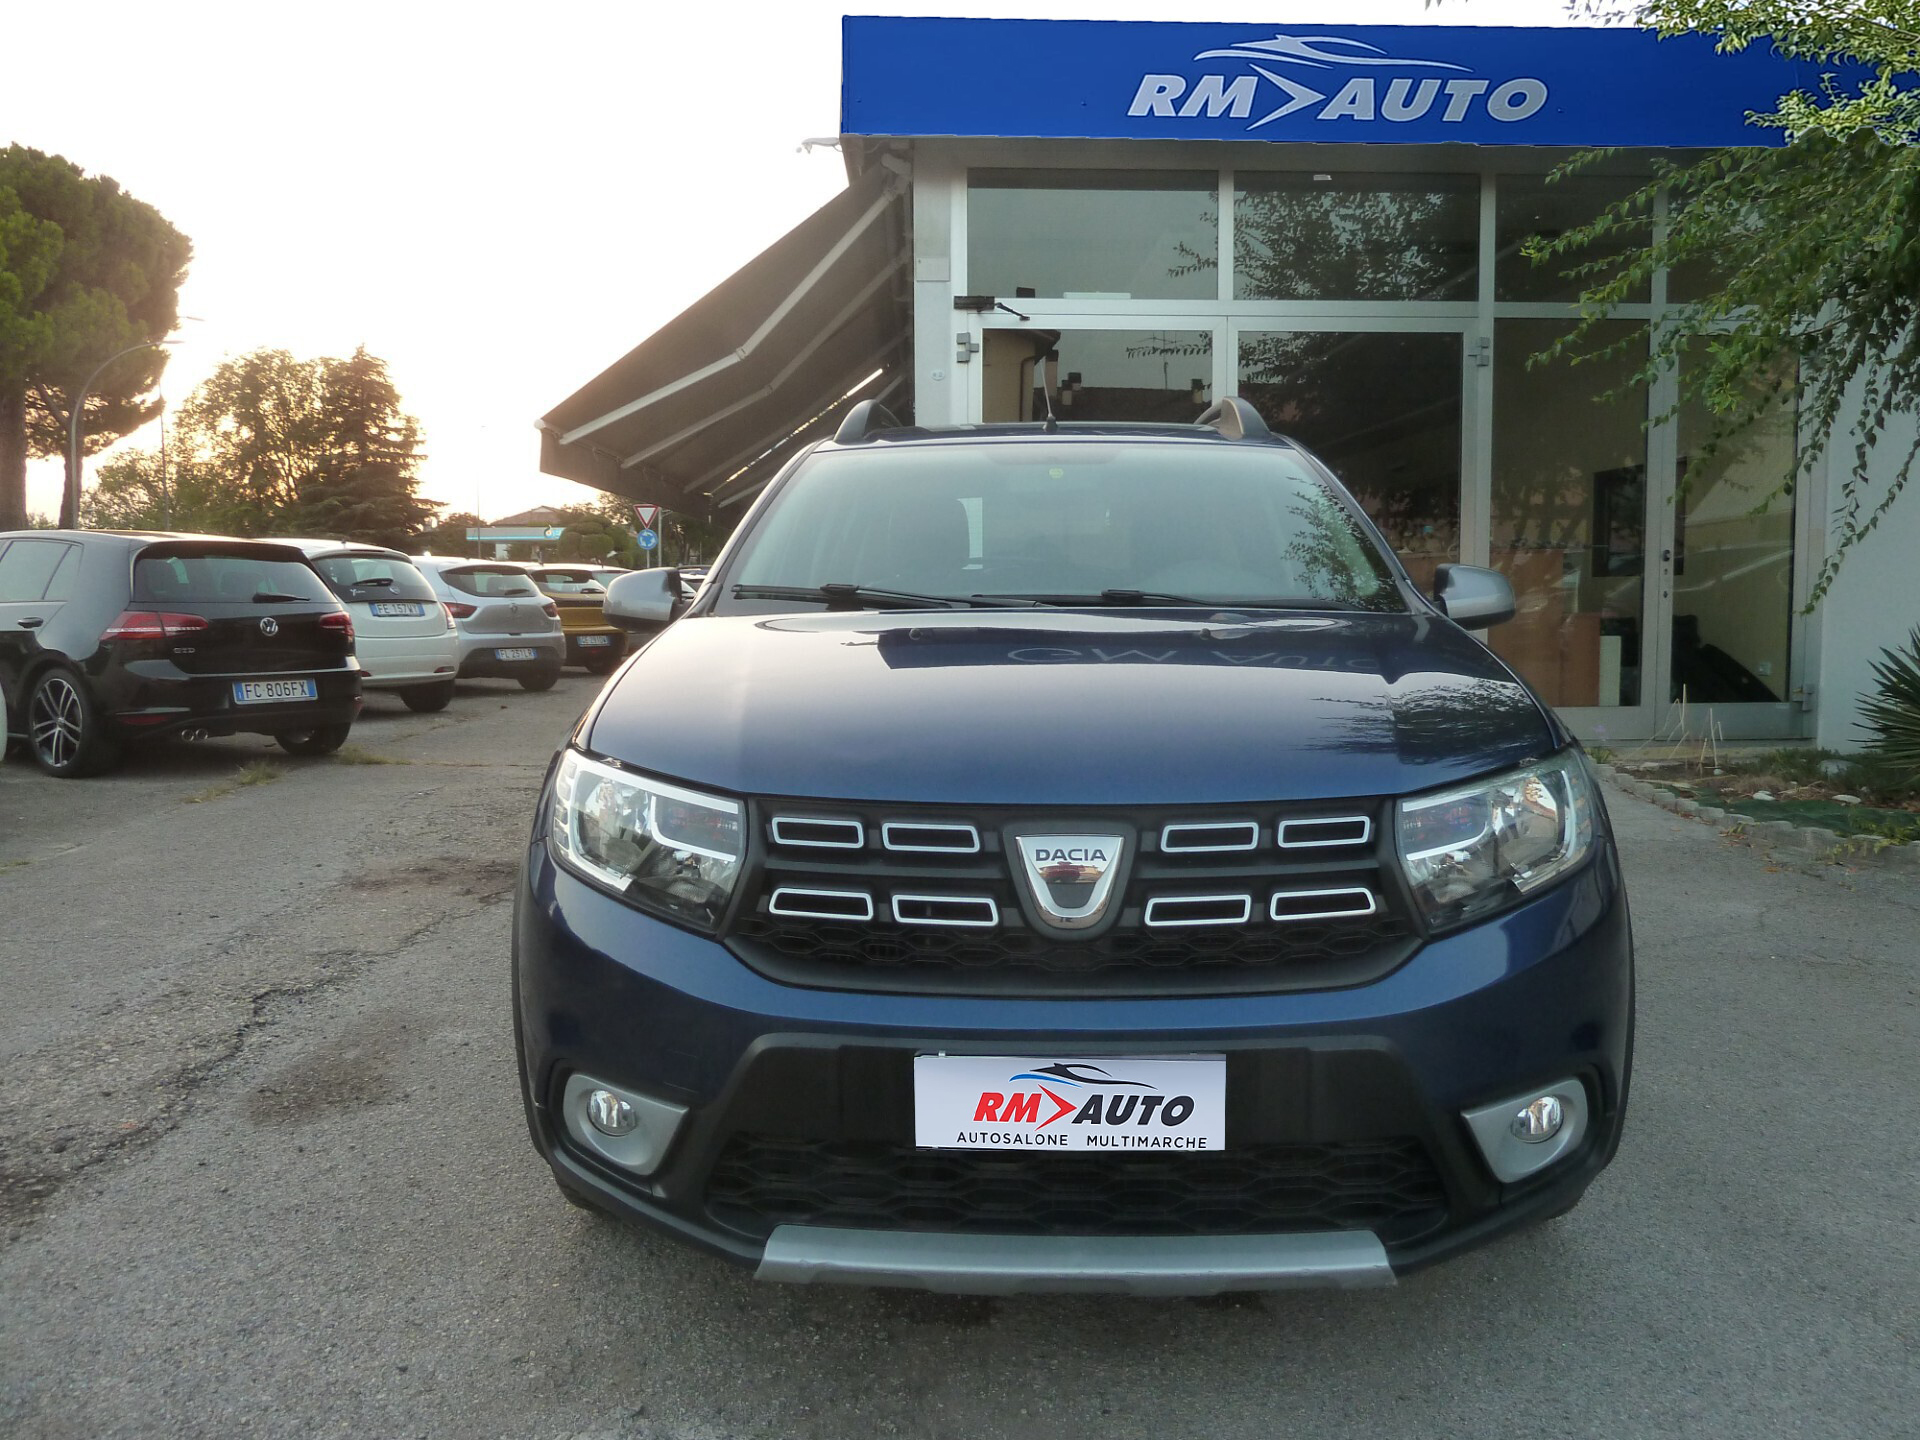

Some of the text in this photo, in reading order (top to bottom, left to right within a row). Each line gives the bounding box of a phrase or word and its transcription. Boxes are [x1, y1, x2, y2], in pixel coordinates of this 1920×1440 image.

[1127, 74, 1548, 122] RM AUTO
[245, 683, 262, 699] FC
[266, 681, 308, 698] 806FX
[1035, 848, 1107, 862] DACIA
[973, 1092, 1195, 1127] RM AUTO
[956, 1131, 1208, 1149] AUTOSALONE MULTIMARCHE
